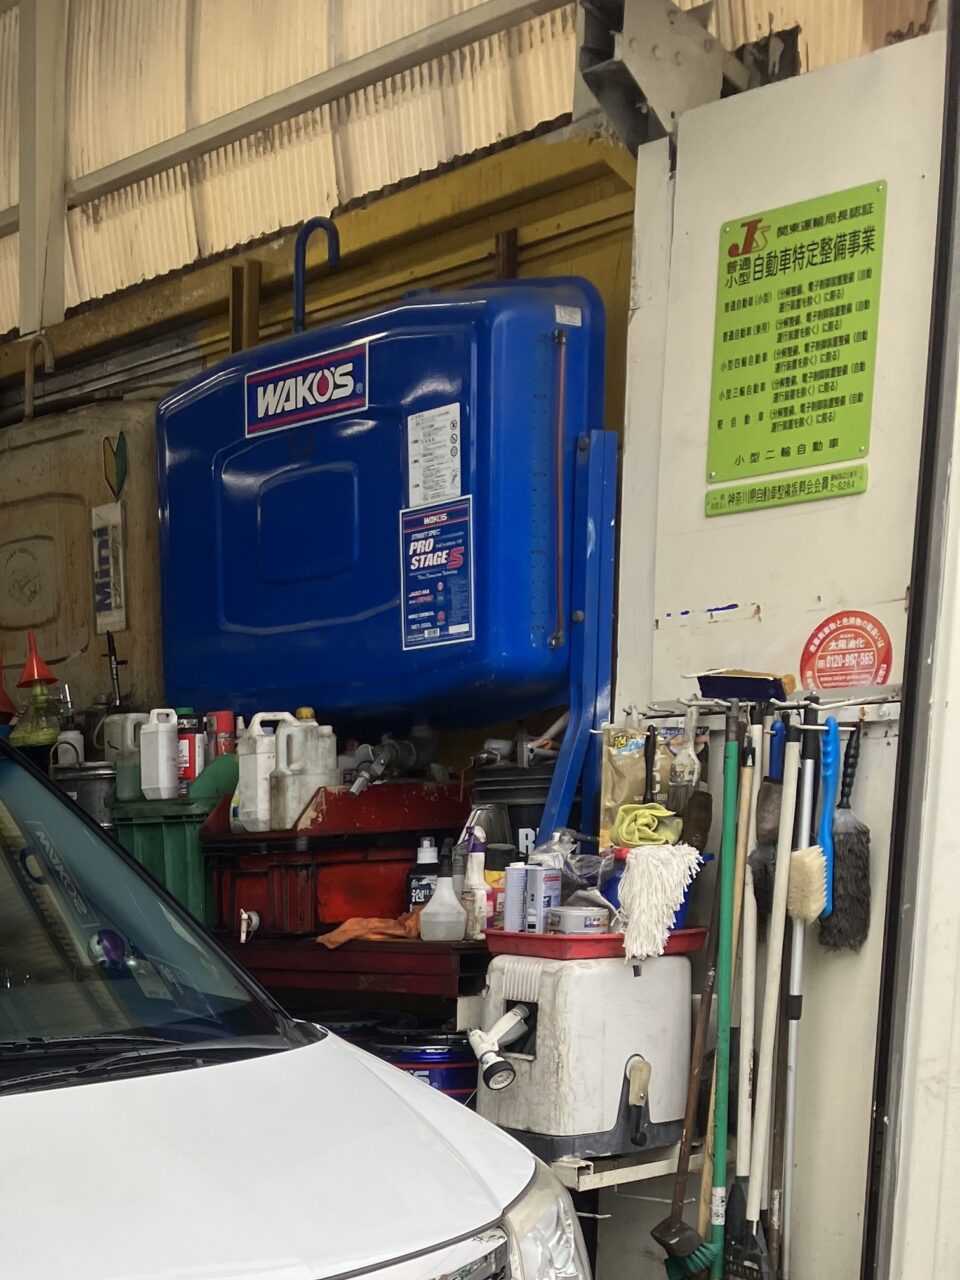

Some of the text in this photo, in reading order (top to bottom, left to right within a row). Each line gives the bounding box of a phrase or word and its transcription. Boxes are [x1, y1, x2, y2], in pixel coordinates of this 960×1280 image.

[752, 223, 876, 282] 自動車特定整備事業
[257, 362, 354, 418] WAKO'S
[409, 538, 434, 555] PRO
[411, 550, 449, 570] STAGE
